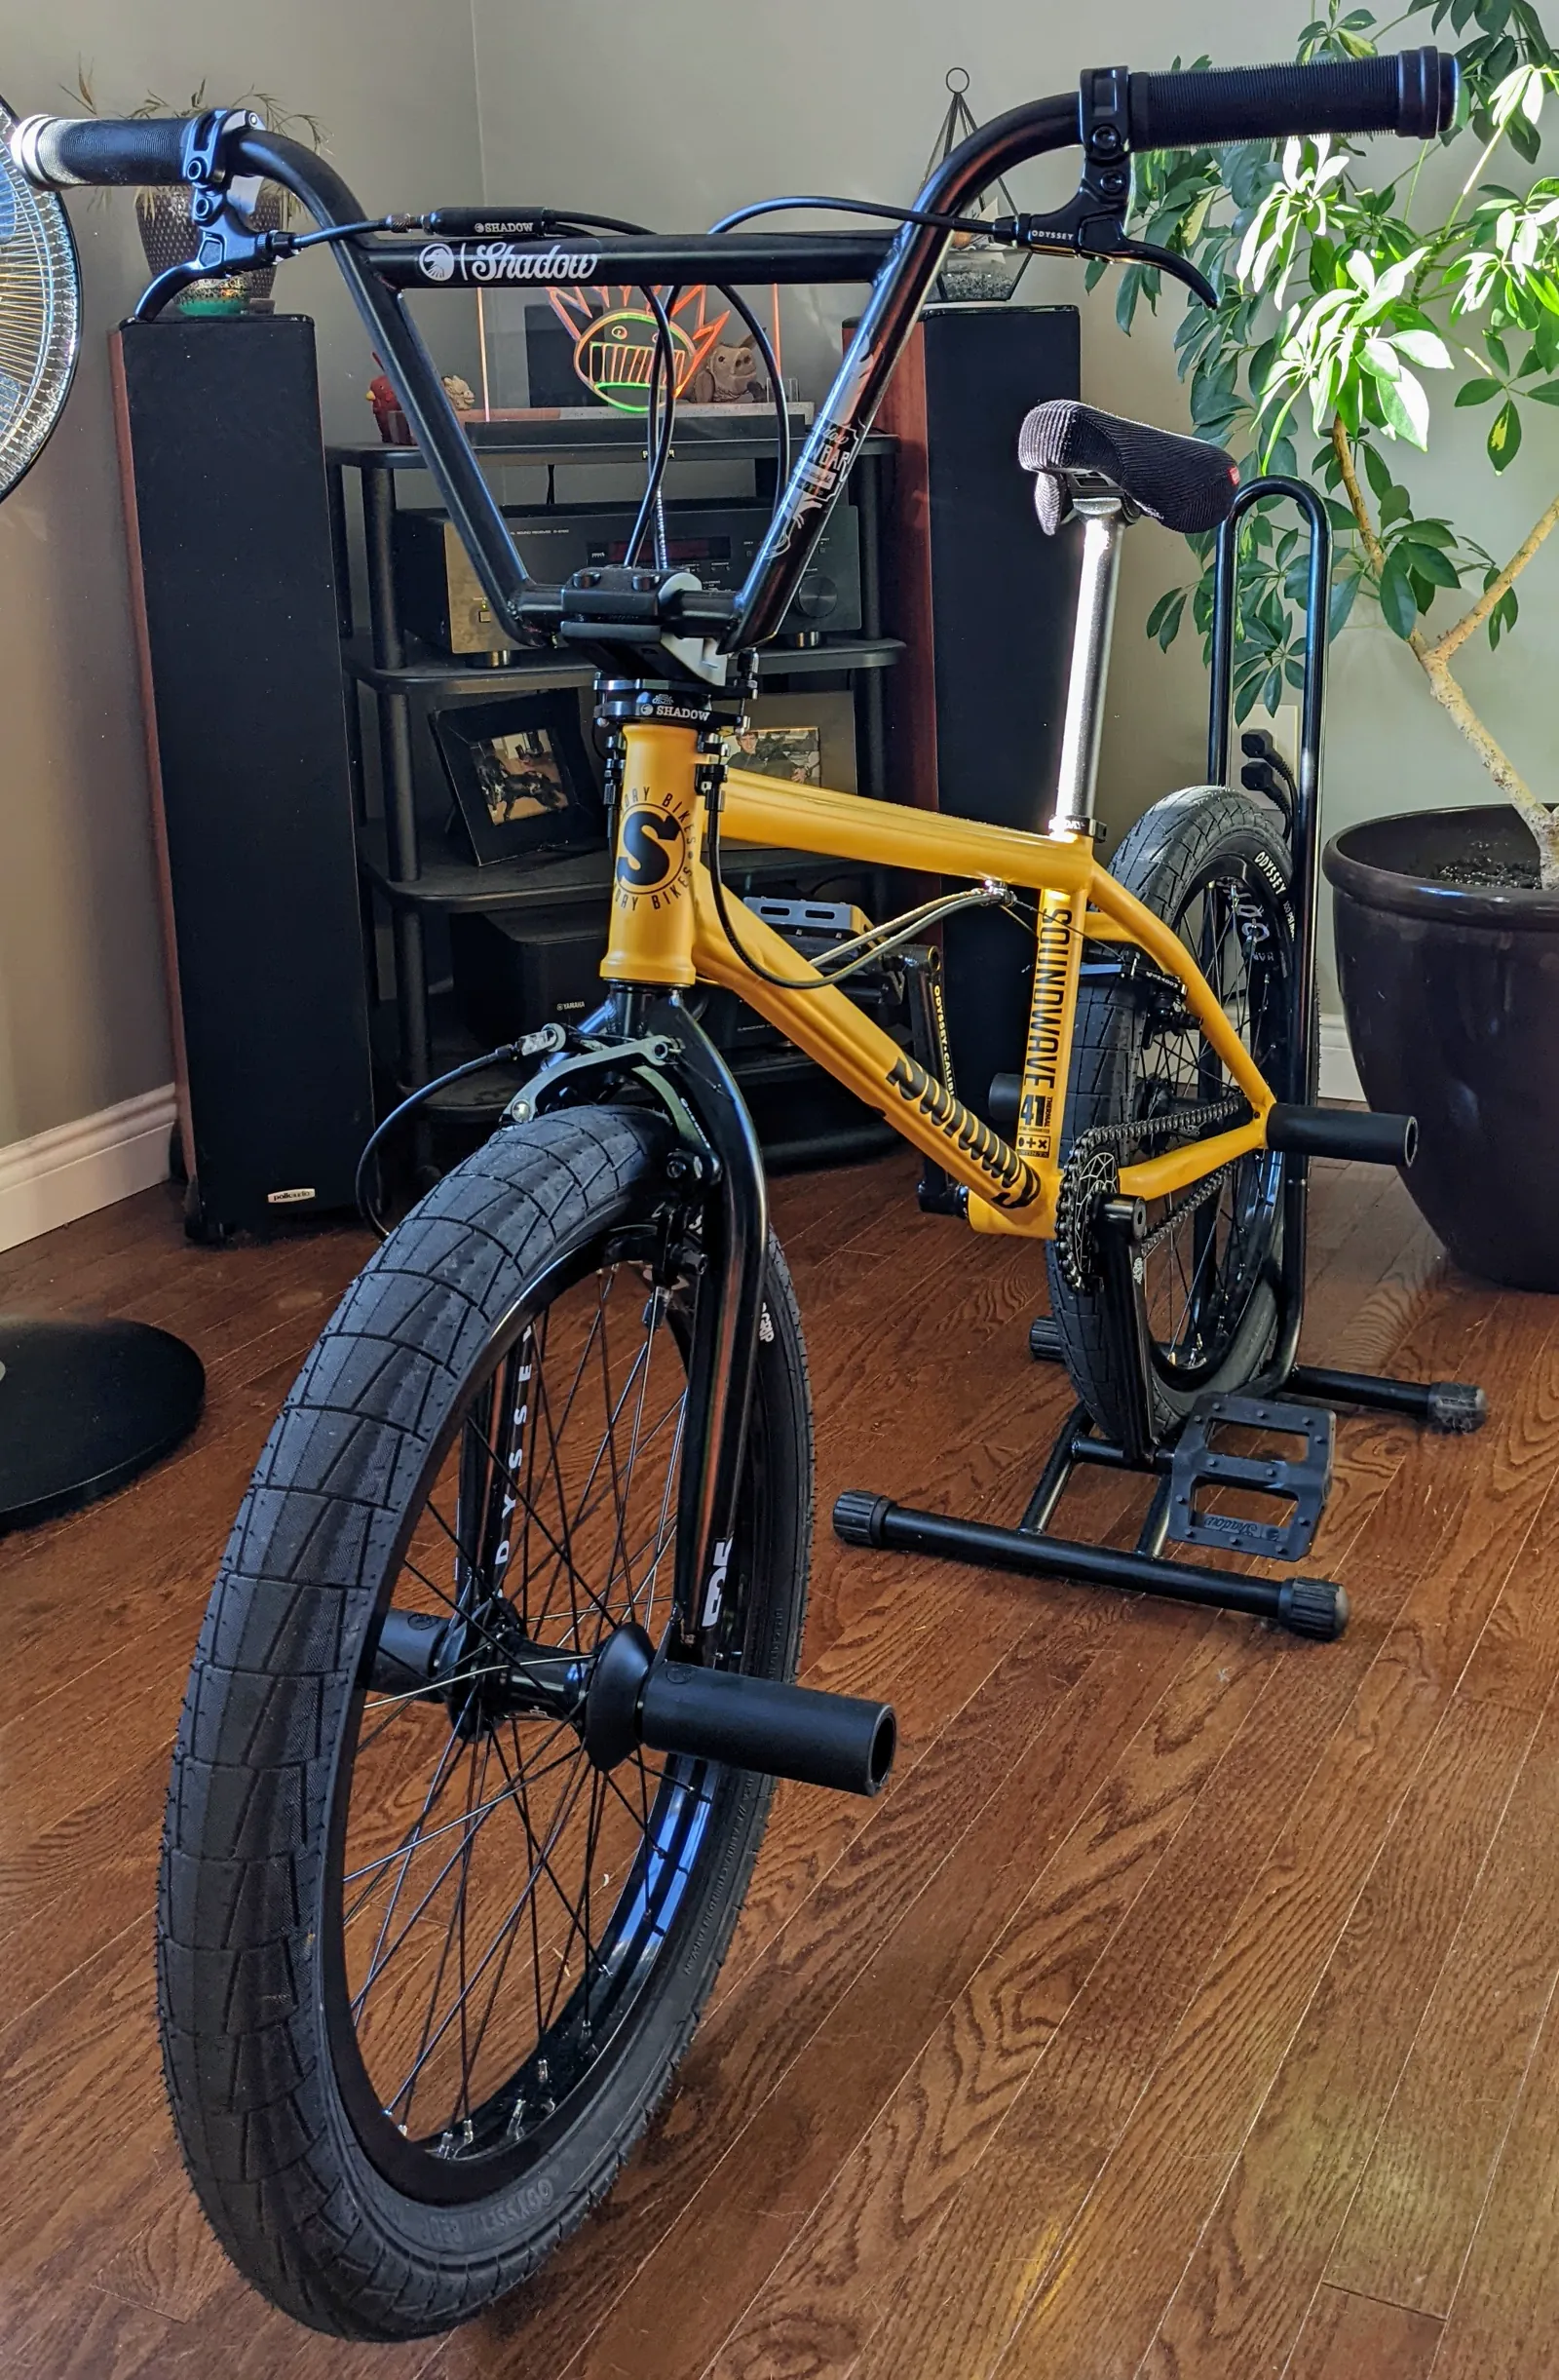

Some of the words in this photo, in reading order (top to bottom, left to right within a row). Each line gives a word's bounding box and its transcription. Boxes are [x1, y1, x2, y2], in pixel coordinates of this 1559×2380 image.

[484, 222, 534, 233] SHADOW
[1031, 230, 1074, 241] ODYSSEY
[472, 242, 598, 280] Shadow
[656, 705, 711, 722] SHADOW
[663, 792, 698, 845] BIKES
[651, 866, 693, 910] BIKES
[1254, 851, 1286, 895] ODYSSEY
[564, 1001, 586, 1010] YAMAHA
[933, 984, 948, 1045] ODYSSEY
[1023, 907, 1073, 1090] SOUNDWAVE
[1020, 1094, 1046, 1127] 41
[1044, 1095, 1053, 1128] THERMAL
[494, 1324, 532, 1600] DYSSE
[1203, 1516, 1258, 1536] Shadow
